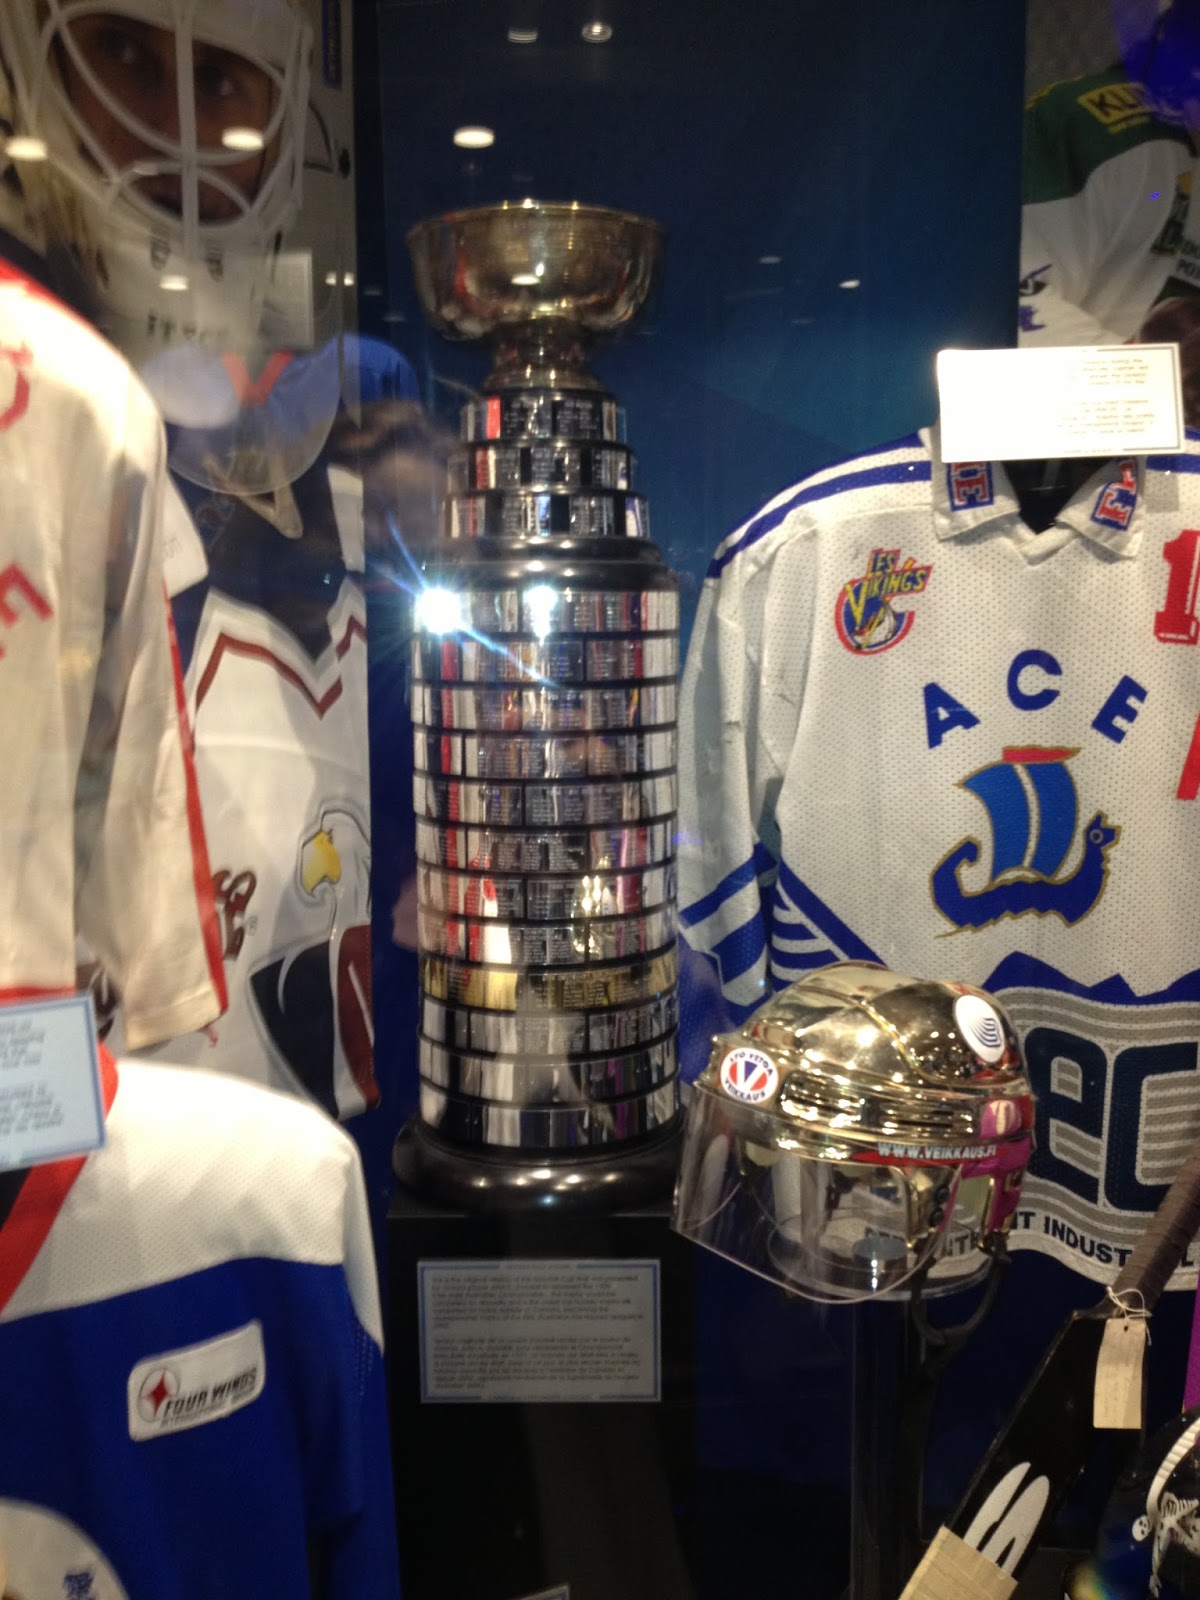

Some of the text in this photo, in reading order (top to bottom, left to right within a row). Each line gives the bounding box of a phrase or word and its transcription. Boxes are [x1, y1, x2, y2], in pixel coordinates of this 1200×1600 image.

[866, 551, 896, 579] LES
[843, 568, 928, 628] VIKINGS
[923, 649, 1148, 749] ACE
[877, 1142, 997, 1160] WWW.VEIKKAUS.FI
[162, 1389, 209, 1419] FOUR
[212, 1367, 257, 1400] WINDS
